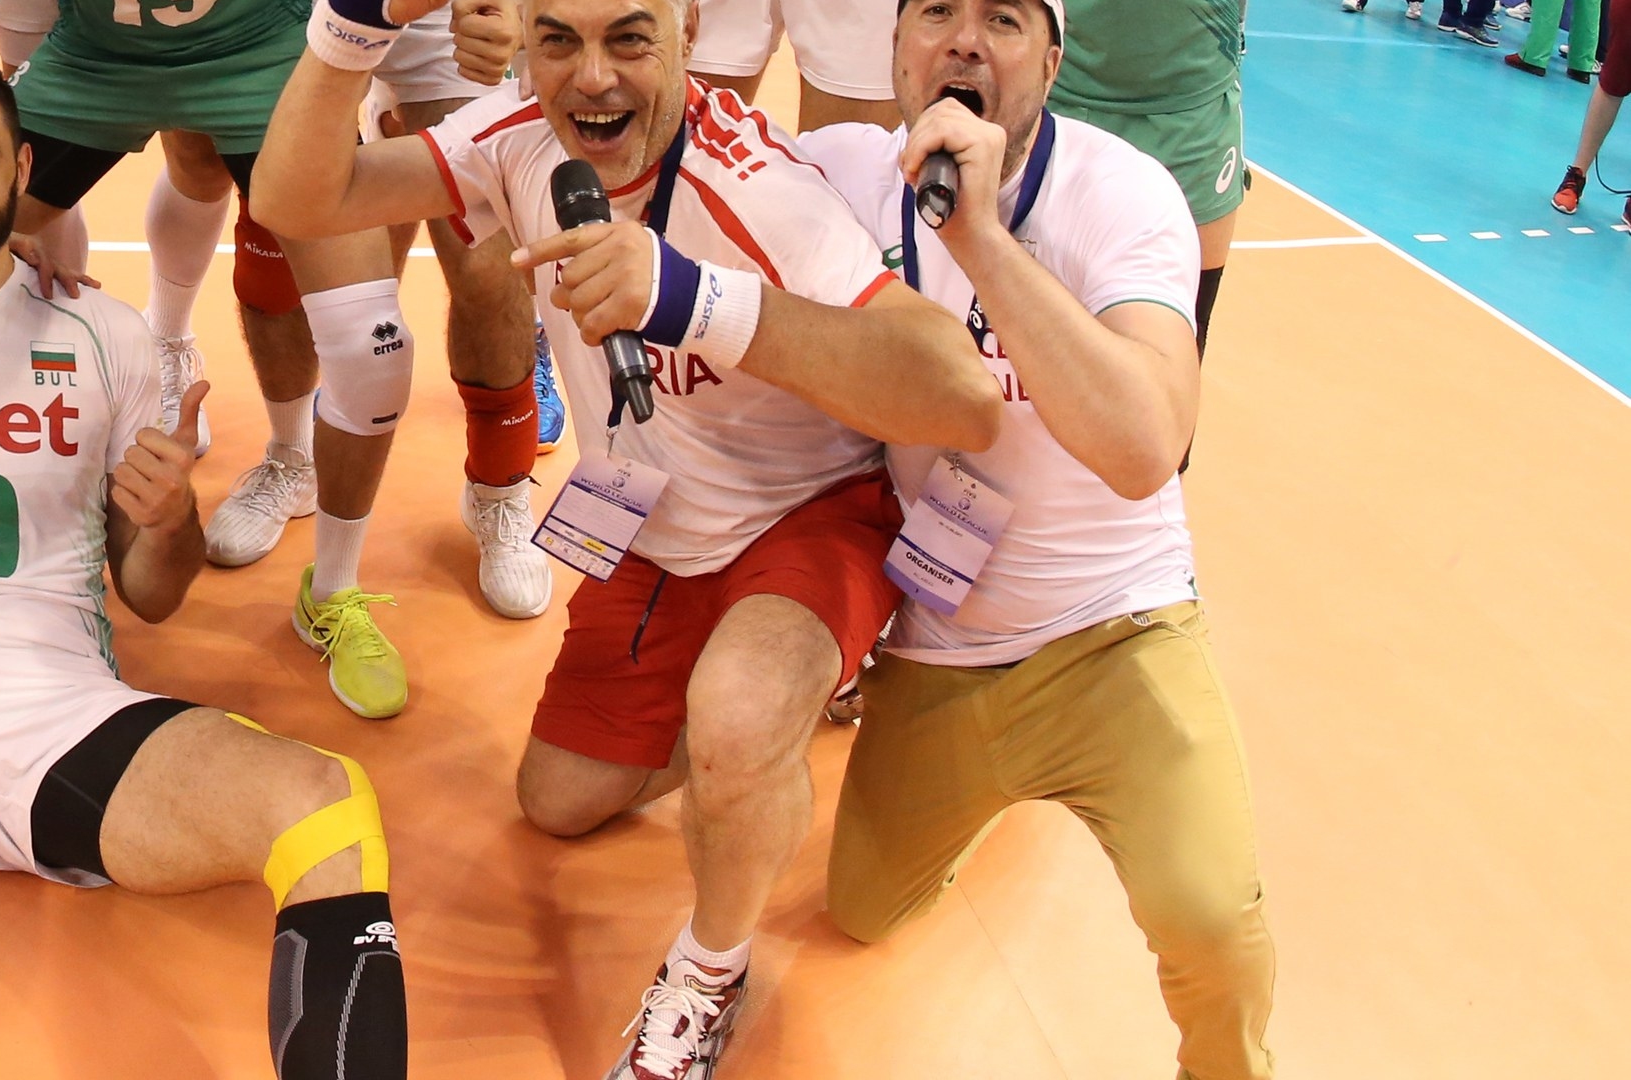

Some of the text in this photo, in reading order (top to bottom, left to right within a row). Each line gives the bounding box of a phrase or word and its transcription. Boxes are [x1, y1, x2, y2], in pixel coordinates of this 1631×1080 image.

[374, 338, 404, 356] errea
[35, 371, 78, 387] BUL
[643, 344, 723, 396] RIA
[580, 477, 611, 495] WORLD
[905, 551, 955, 586] ORGANISER
